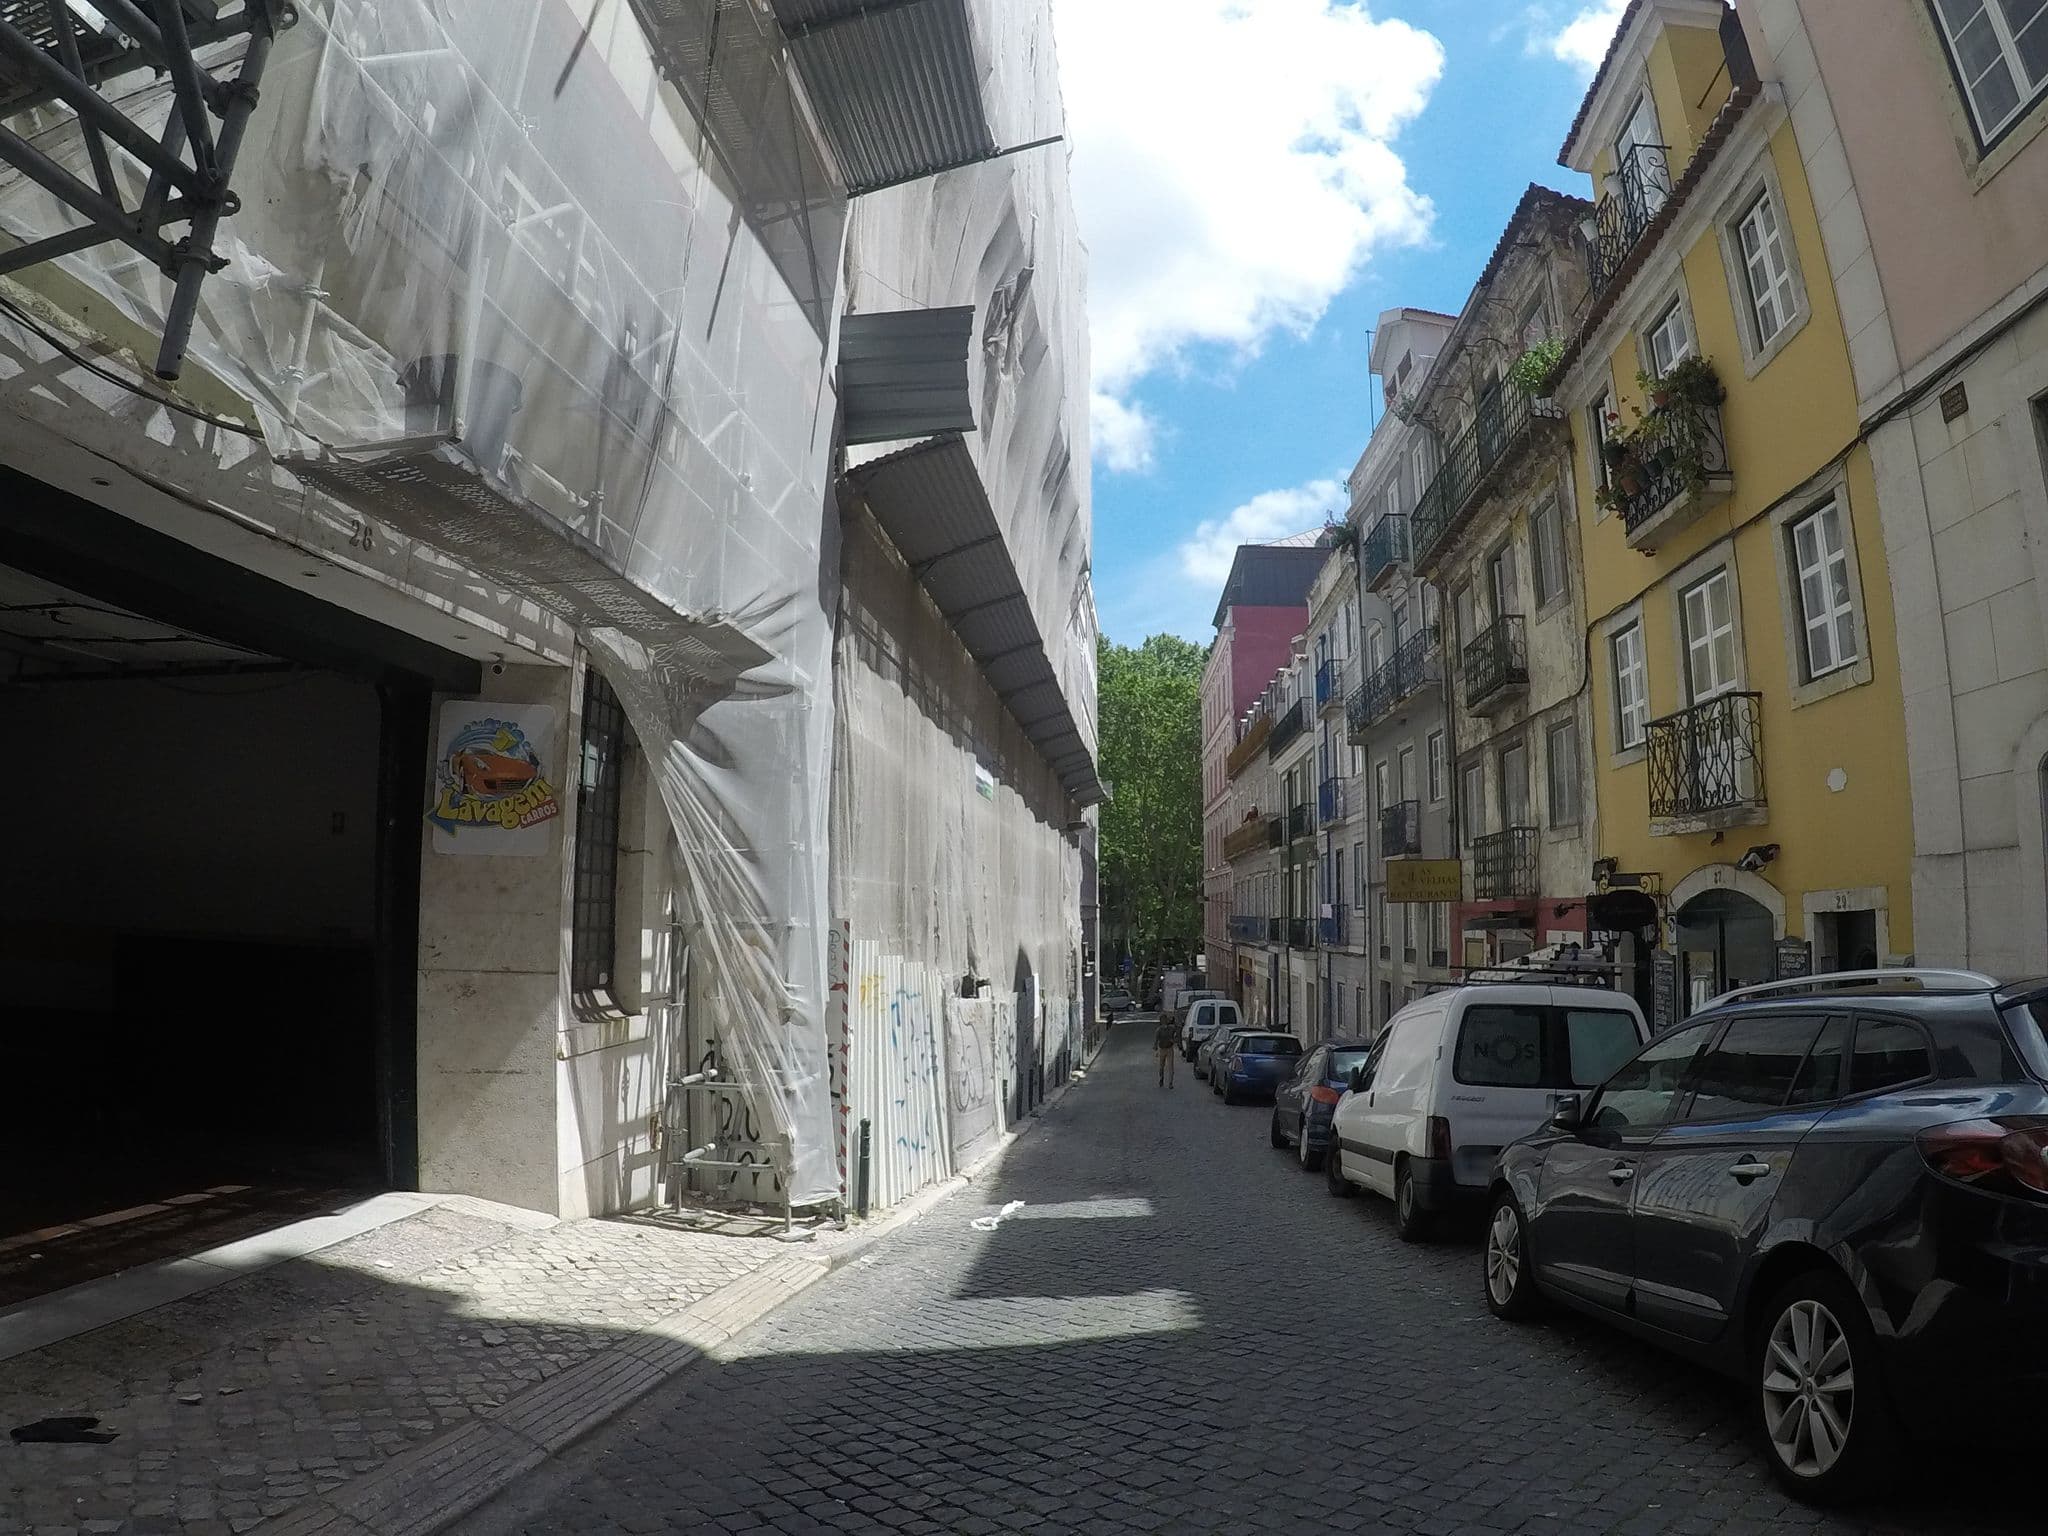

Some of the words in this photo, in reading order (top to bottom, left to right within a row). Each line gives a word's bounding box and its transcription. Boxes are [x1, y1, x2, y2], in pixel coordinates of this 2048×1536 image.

[349, 519, 373, 551] 28
[437, 777, 553, 829] Lavagem
[520, 803, 558, 825] CARROS
[1836, 894, 1847, 910] 29
[1474, 1036, 1536, 1062] NOS
